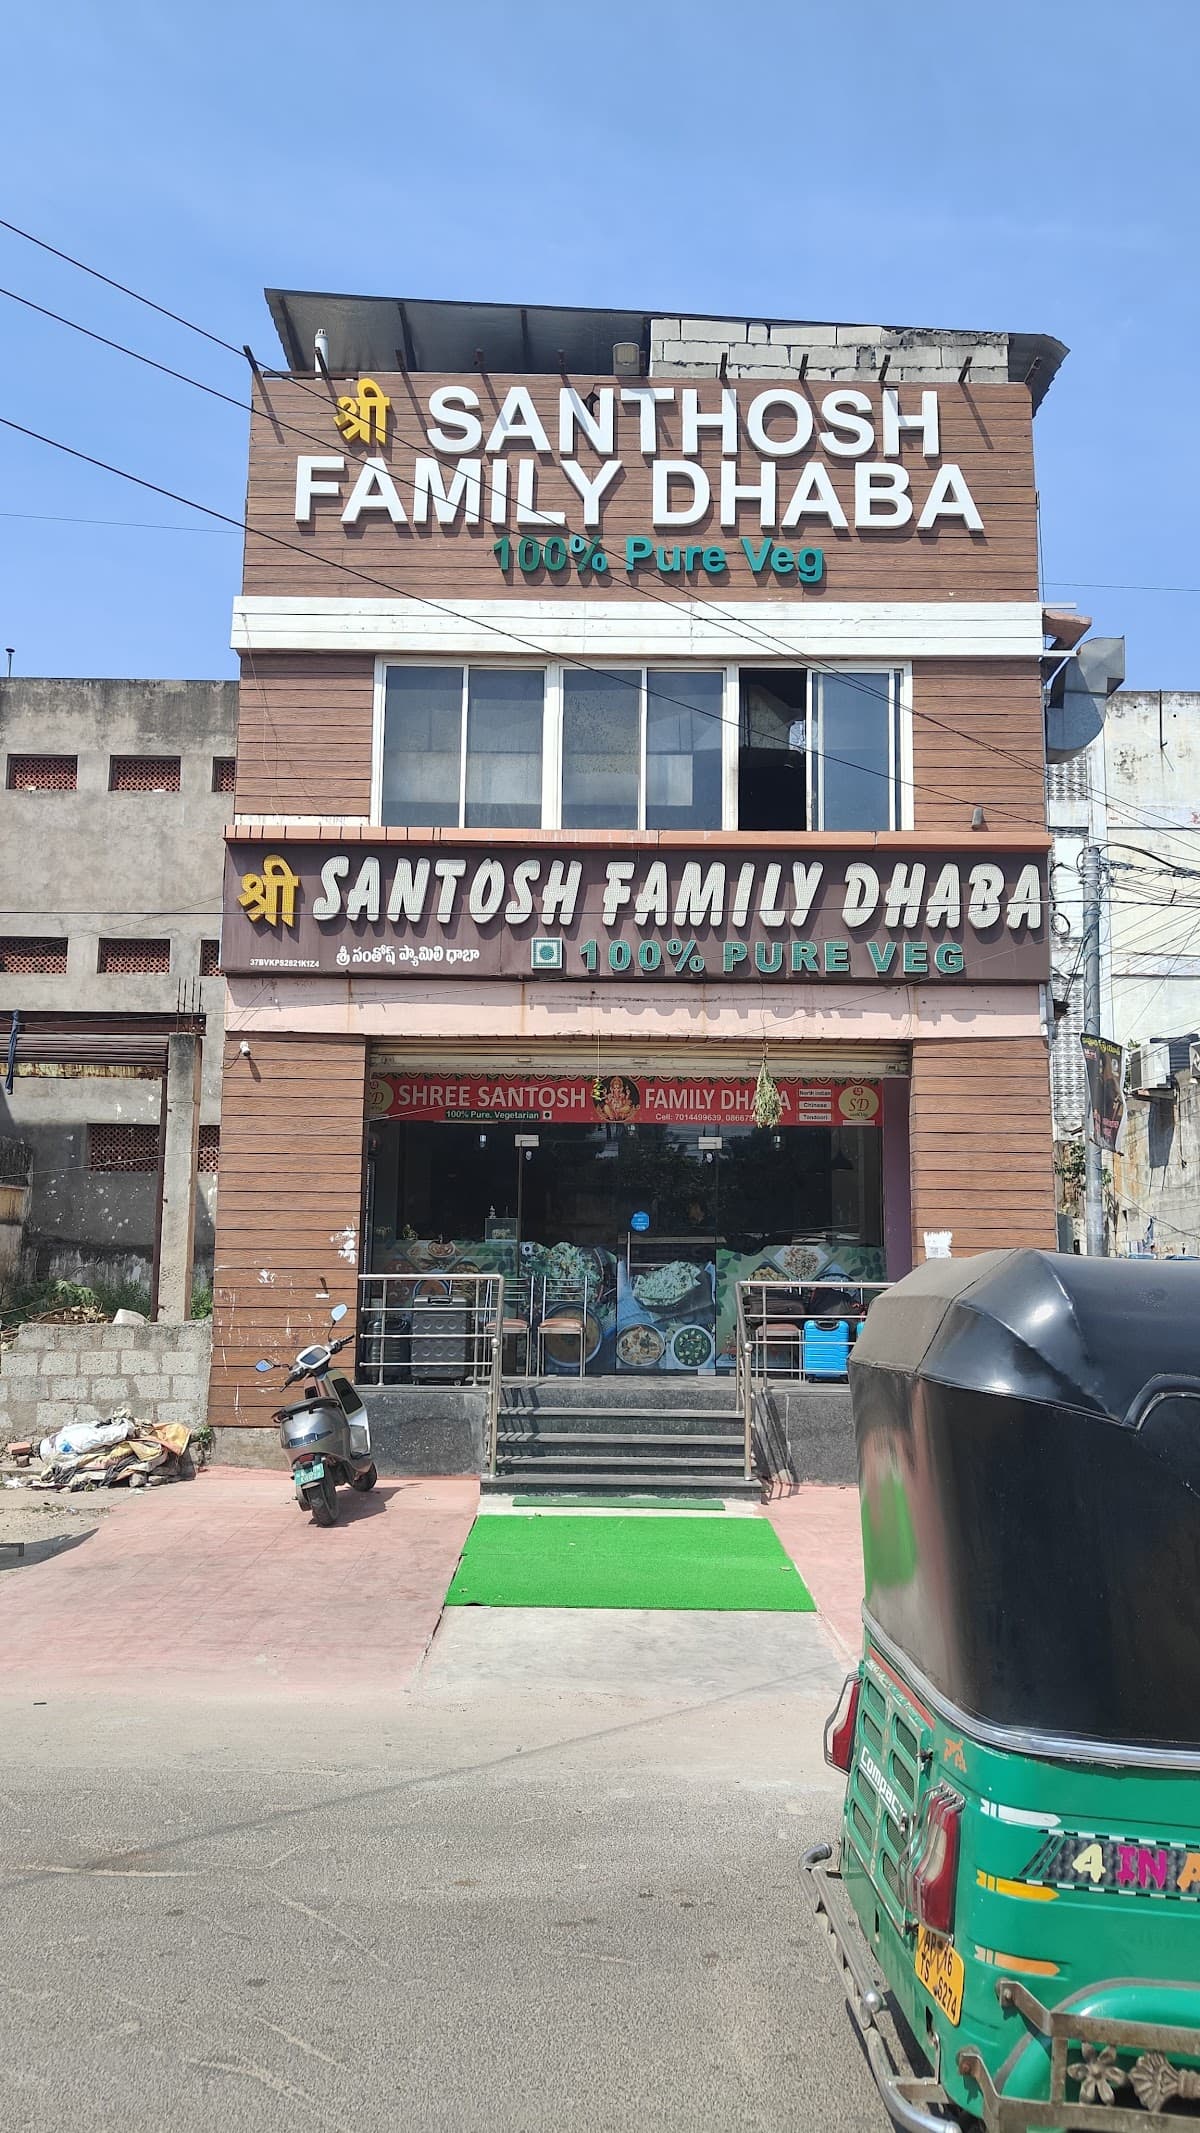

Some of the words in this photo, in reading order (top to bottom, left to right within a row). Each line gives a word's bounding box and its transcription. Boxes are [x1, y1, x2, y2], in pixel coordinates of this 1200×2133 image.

[333, 378, 391, 446] श्री
[427, 384, 940, 459] SANTHOSH
[294, 455, 622, 526] FAMILY
[652, 459, 985, 531] DHABA
[492, 535, 606, 574] 100%
[625, 536, 727, 574] Pure
[740, 536, 824, 584] Veg
[237, 854, 300, 928] श्री
[312, 855, 582, 926] SANTOSH
[602, 861, 824, 927] FAMILY
[841, 862, 1041, 930] DHABA
[579, 938, 705, 973] 100%
[722, 941, 850, 974] PURE
[865, 941, 964, 974] VEG
[398, 1085, 470, 1107] SHREE
[478, 1086, 586, 1108] SANTOSH
[645, 1088, 715, 1110] FAMILY
[720, 1089, 792, 1111] DHAA
[446, 1110, 469, 1119] 100%
[494, 1111, 539, 1120] Vegetarian
[655, 1113, 673, 1122] Cell:
[1072, 1843, 1106, 1884] 4
[1116, 1844, 1167, 1889] IN
